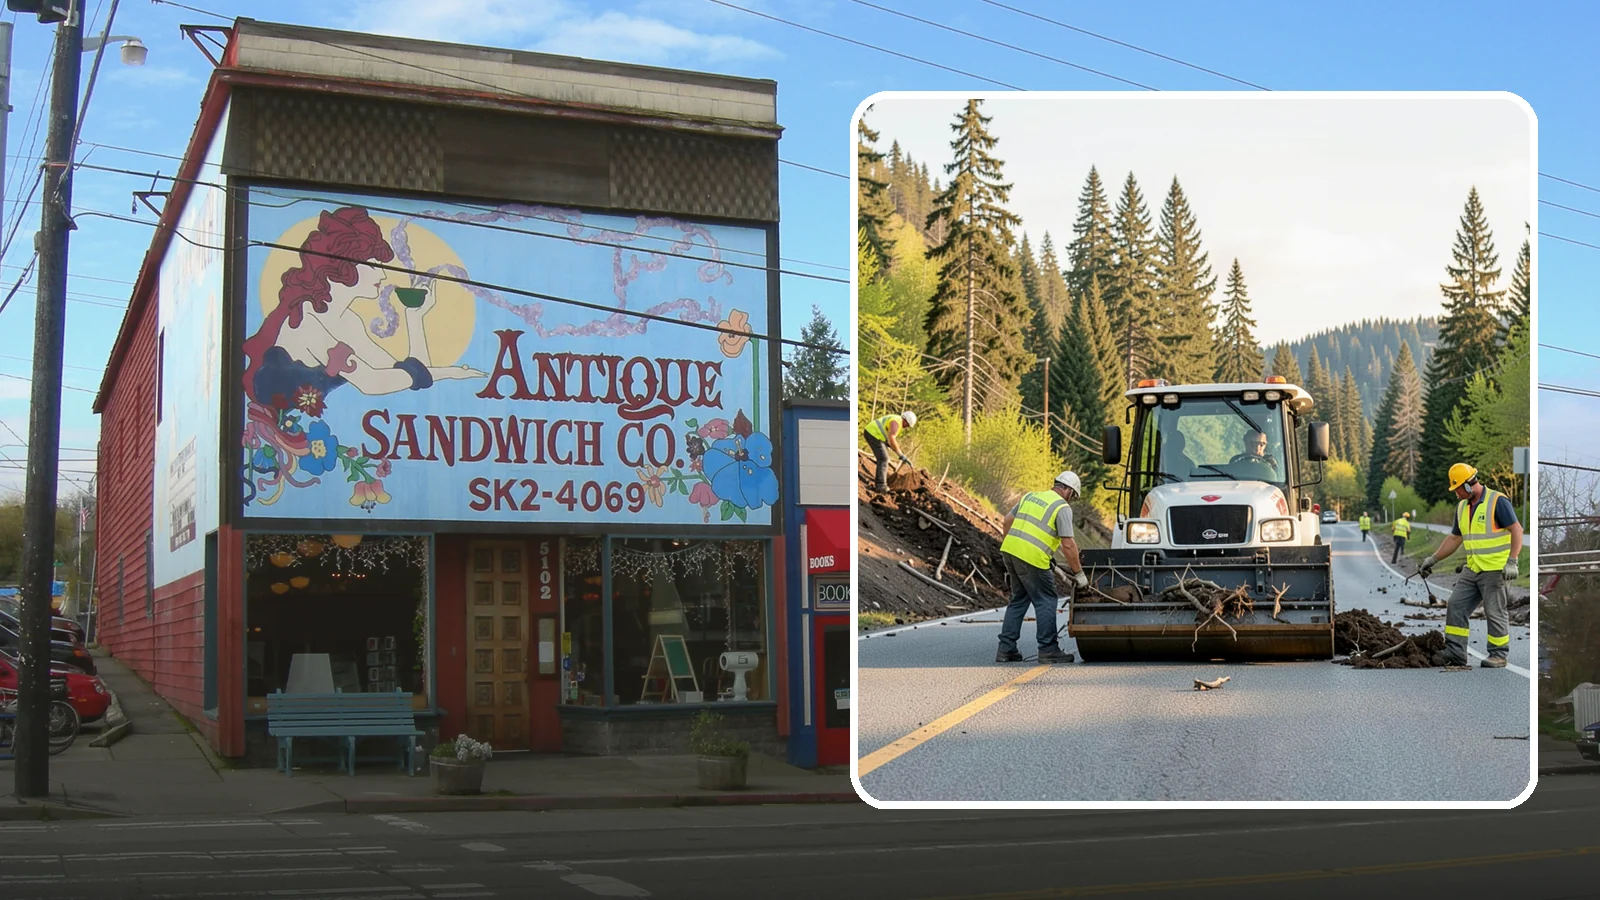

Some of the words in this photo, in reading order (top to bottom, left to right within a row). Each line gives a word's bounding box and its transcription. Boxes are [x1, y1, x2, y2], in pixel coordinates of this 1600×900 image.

[477, 330, 723, 420] ANTIQUE
[362, 410, 604, 467] SANDWICH
[617, 422, 685, 468] CO.
[469, 478, 645, 512] SK2-4069
[540, 543, 551, 599] 5102
[810, 555, 835, 568] BOOKS
